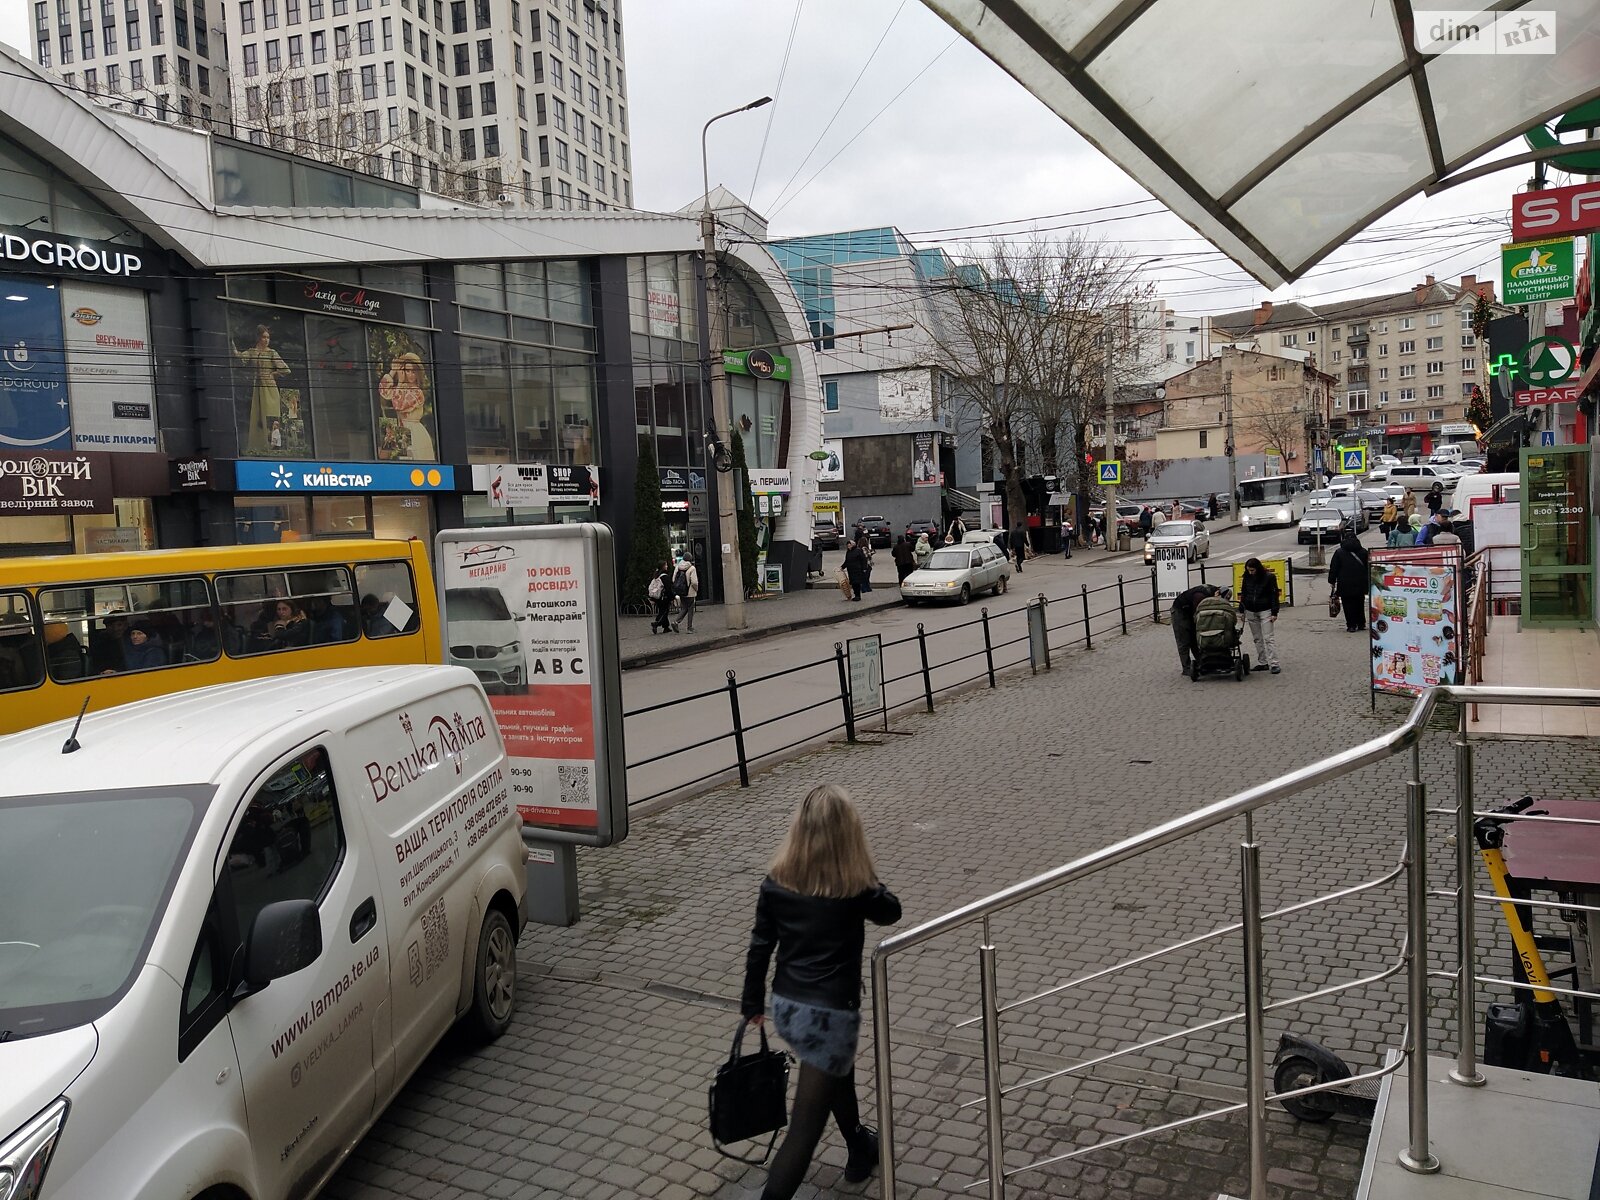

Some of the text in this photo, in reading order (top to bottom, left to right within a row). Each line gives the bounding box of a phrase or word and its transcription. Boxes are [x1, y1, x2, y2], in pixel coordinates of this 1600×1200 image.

[1518, 264, 1558, 276] ЕМАУС
[1506, 275, 1573, 288] ПАЛОМНИЦЬКО-
[304, 280, 380, 309] Захід Мода
[1508, 282, 1569, 296] ТУРИСТИЧНИЙ
[1526, 292, 1551, 300] ЦЕНТР
[117, 338, 144, 350] ANATOMY
[1518, 390, 1577, 403] SPAR
[76, 434, 156, 444] КРАЩЕ ЛІКАРЯМ
[303, 468, 372, 487] КИЇВСТАР
[518, 467, 542, 477] WOMEN
[553, 468, 572, 477] SHOP
[21, 476, 64, 496] ВІК
[760, 476, 789, 485] ПЕРШИЙ
[62, 500, 94, 508] завод
[1157, 548, 1186, 561] ПОЗИКА
[469, 563, 507, 578] МЕГАДРАЙВ
[527, 566, 571, 577] 10 РОКІВ
[528, 580, 578, 592] ДОСВІДУ!
[1393, 577, 1427, 586] SPAR
[526, 600, 577, 608] Автошкола
[551, 726, 574, 734] графік
[438, 715, 486, 761] Лампа
[537, 733, 583, 744] інструктором
[365, 741, 438, 803] Велика
[510, 768, 532, 777] 90-90
[396, 769, 504, 864] ВАША ТЕРИТОРІЯ СВІТЛА
[464, 816, 475, 832] +38
[475, 808, 485, 823] 098
[467, 833, 477, 848] +38
[271, 945, 380, 1059] www.lampa.te.ua
[303, 1001, 364, 1070] VELYKA_LAMPA
